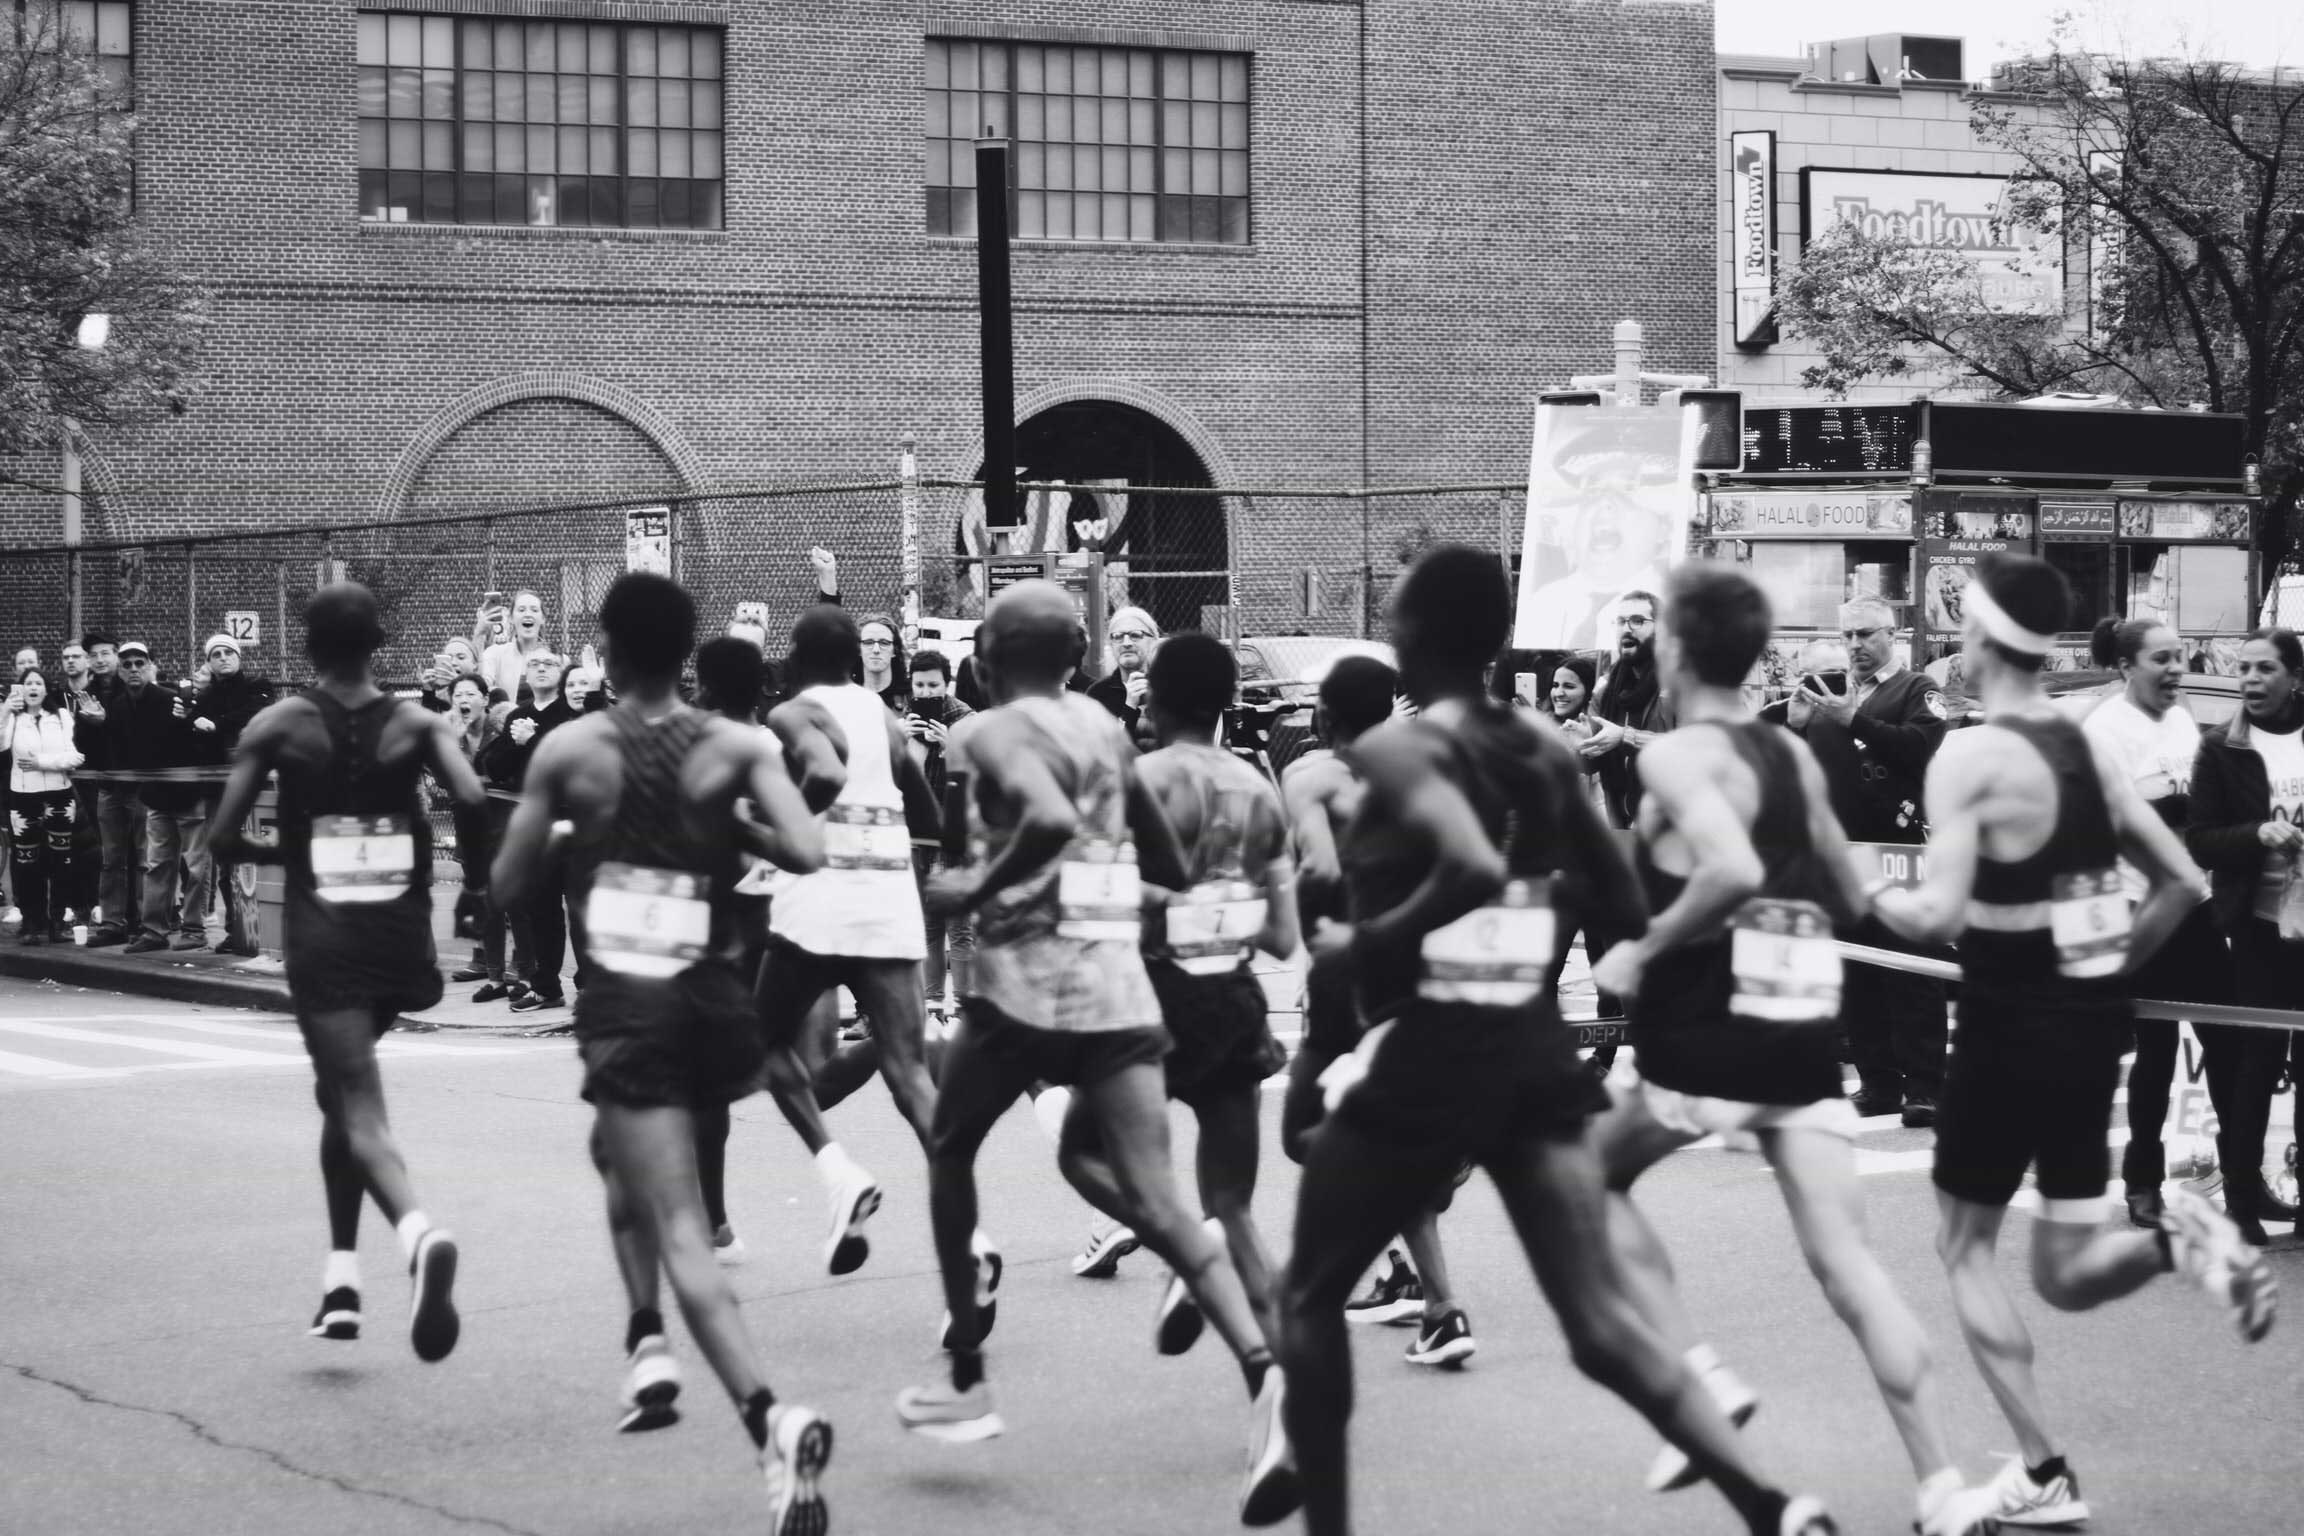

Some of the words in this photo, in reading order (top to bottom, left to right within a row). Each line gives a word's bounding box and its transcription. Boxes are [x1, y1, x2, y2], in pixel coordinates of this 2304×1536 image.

[1744, 161, 1765, 277] Foodtown
[1757, 506, 1804, 525] HALAL
[1823, 506, 1865, 524] FOOD
[1949, 541, 1979, 551] HALAL
[1981, 542, 2007, 551] FOOD
[1929, 556, 1956, 564] CHICKEN
[1958, 556, 1976, 564] GYRO
[231, 617, 253, 640] 12
[1926, 634, 1949, 642] FALAFEL
[2075, 647, 2089, 657] OVE
[356, 841, 369, 864] 4
[1882, 853, 1908, 881] DO
[1215, 909, 1225, 934] 7
